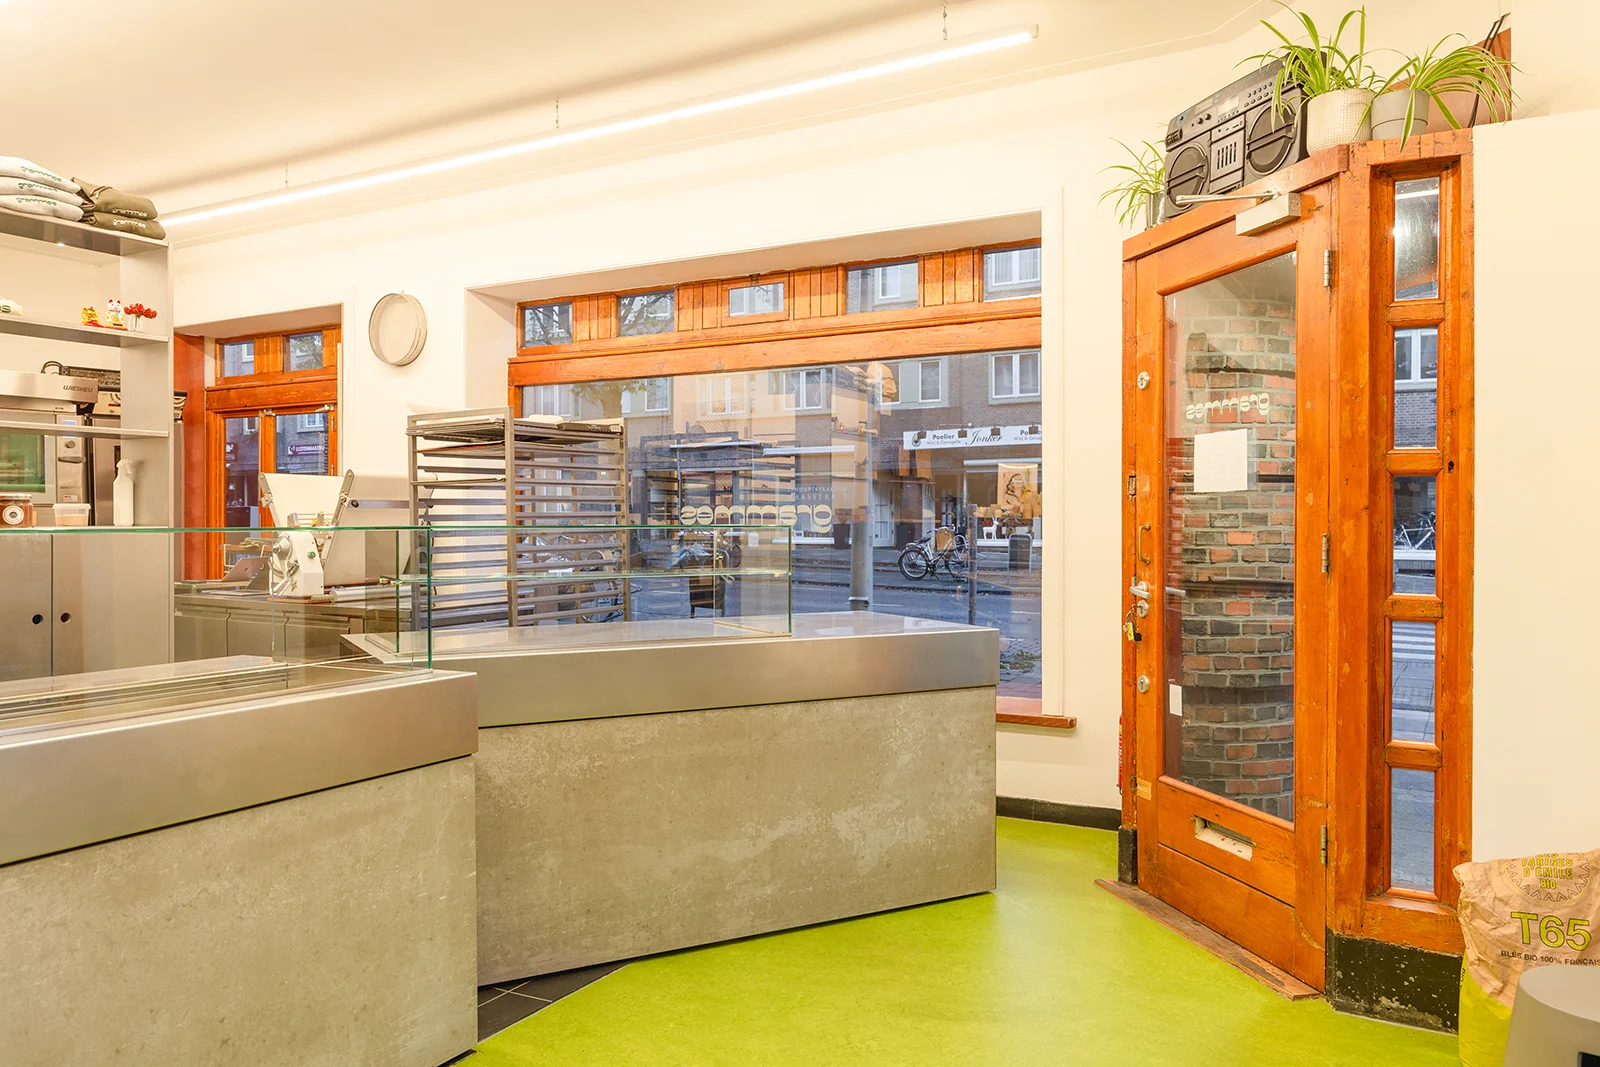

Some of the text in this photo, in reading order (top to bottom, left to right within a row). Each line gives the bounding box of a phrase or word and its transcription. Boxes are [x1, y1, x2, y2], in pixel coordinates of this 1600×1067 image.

[965, 429, 1003, 445] Jonker
[1521, 857, 1573, 867] FARINES
[1539, 878, 1557, 889] BIO
[1510, 911, 1592, 952] T65
[1524, 953, 1538, 962] BIO
[1540, 956, 1562, 965] 100%
